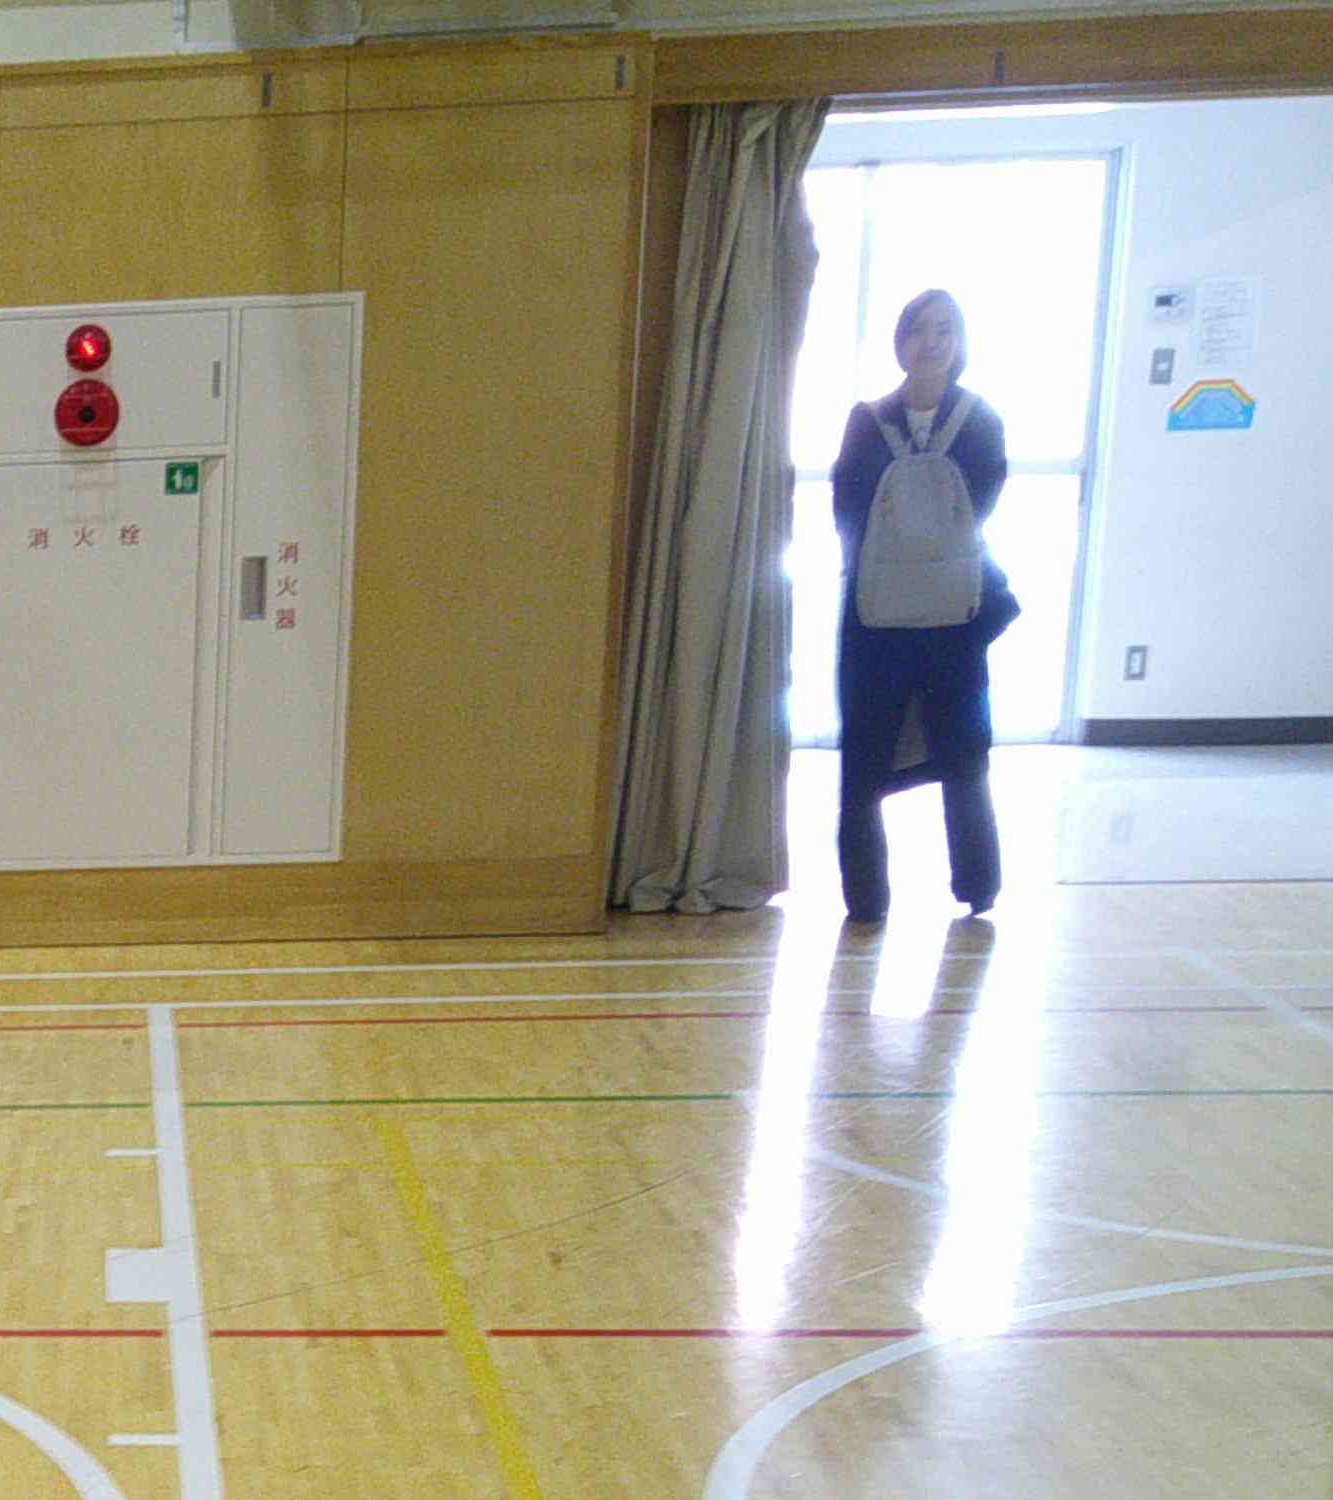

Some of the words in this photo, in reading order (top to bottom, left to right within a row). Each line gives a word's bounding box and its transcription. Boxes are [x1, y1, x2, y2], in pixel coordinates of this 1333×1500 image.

[27, 523, 143, 549] 消火栓
[276, 542, 299, 629] 消火器
